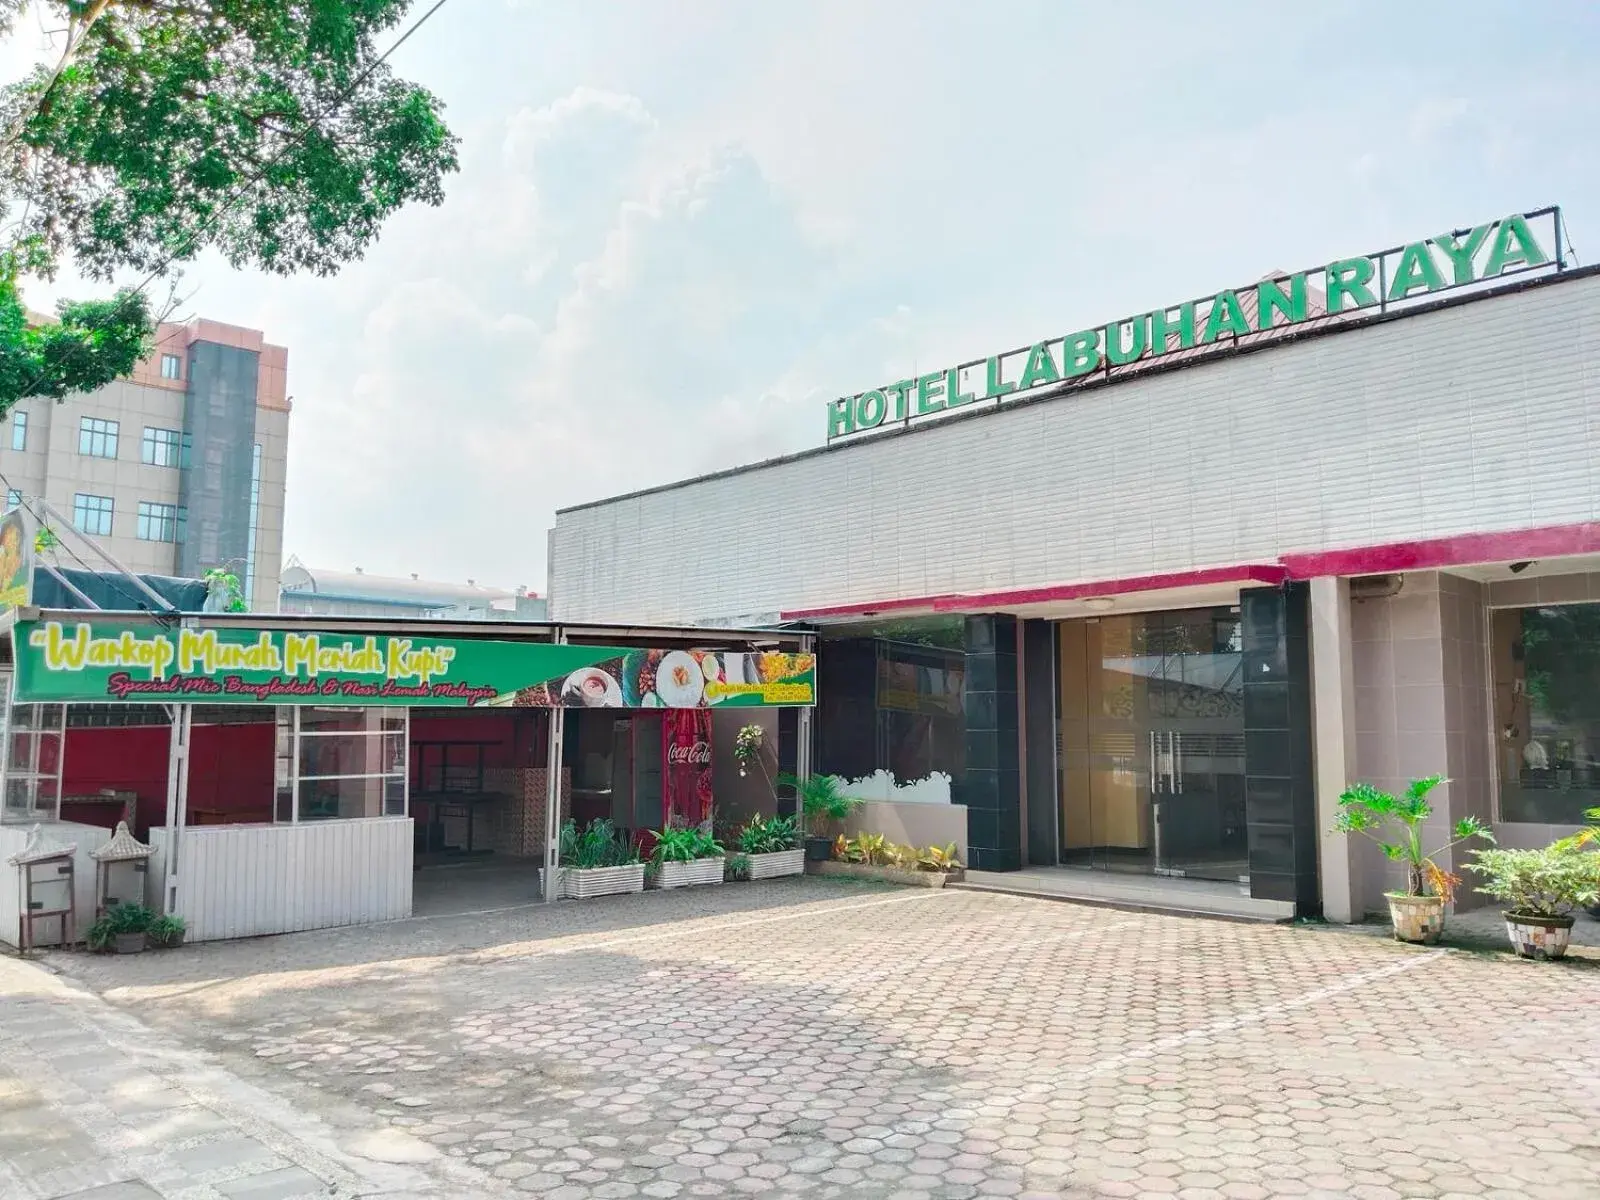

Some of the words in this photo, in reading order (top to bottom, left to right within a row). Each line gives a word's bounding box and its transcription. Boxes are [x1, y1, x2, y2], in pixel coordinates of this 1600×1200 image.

[828, 368, 974, 438] HOTEL
[986, 275, 1307, 396] LABUHAN
[1327, 214, 1549, 316] RAYA
[179, 627, 282, 674] Murah
[285, 633, 385, 676] Meriah
[108, 672, 182, 698] Special
[223, 675, 318, 701] Bangladesh
[320, 679, 340, 694] &
[341, 681, 379, 696] Nasi
[378, 679, 430, 697] Lemak
[431, 681, 498, 706] Malaysia
